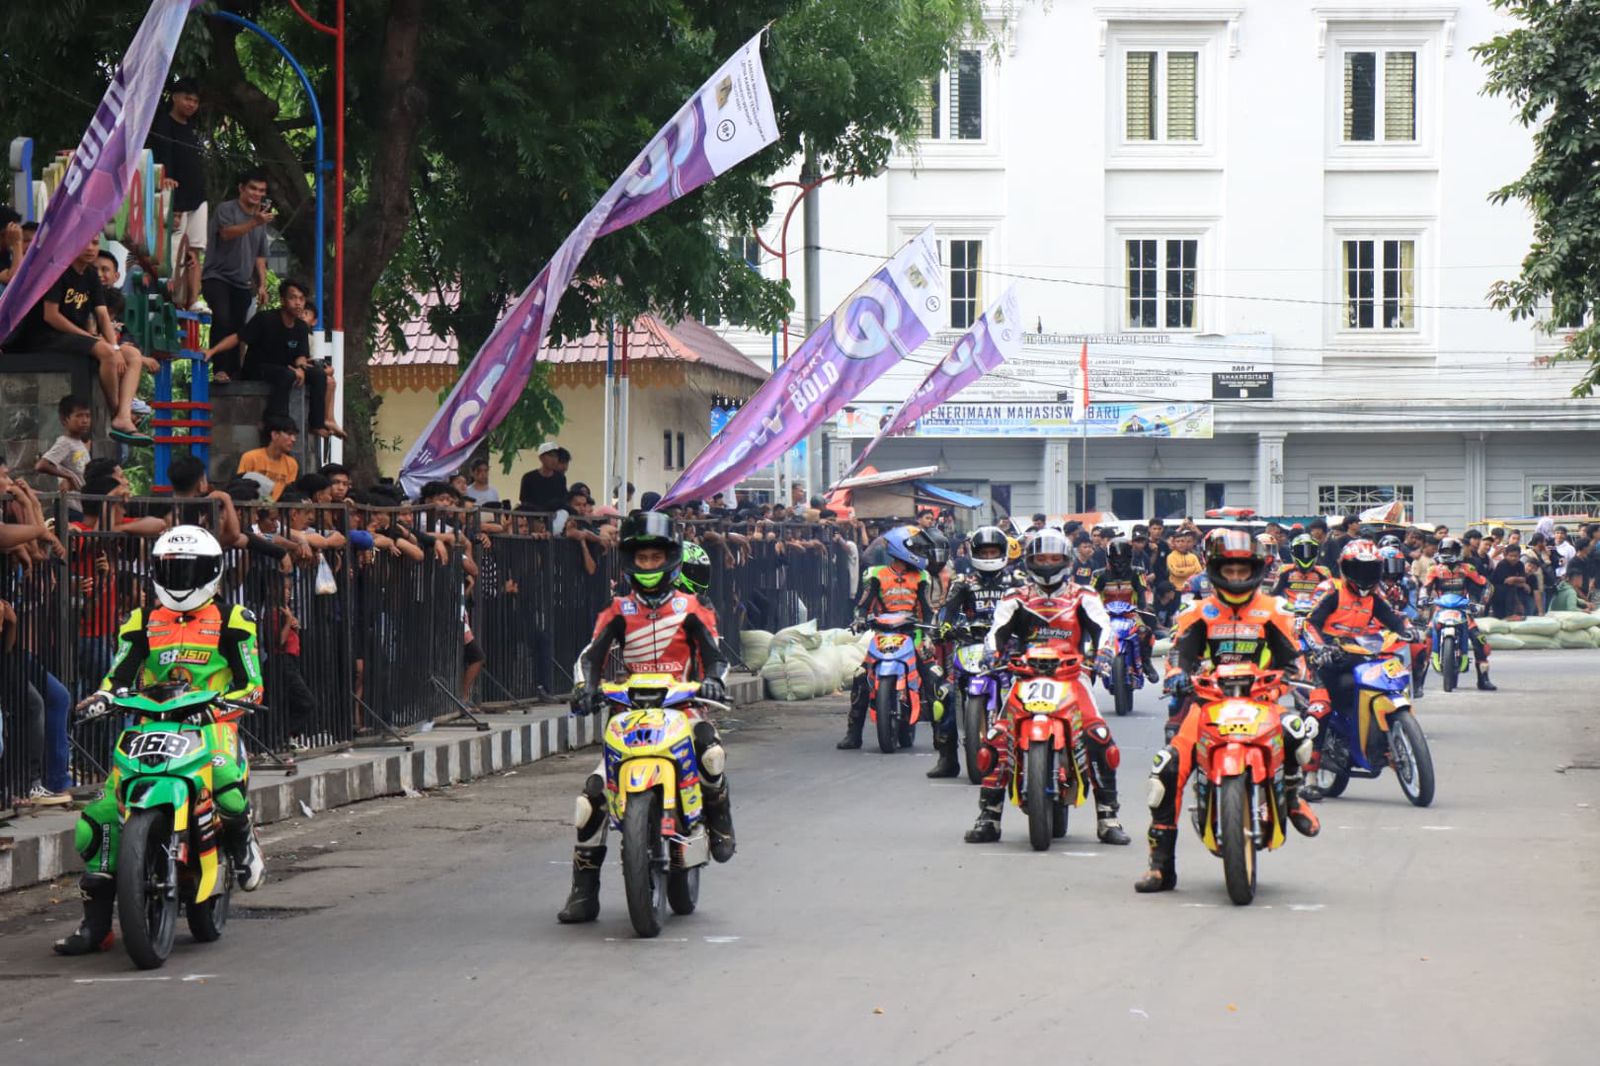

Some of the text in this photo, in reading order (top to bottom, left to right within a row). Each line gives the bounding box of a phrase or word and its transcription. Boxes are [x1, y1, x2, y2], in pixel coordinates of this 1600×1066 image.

[790, 360, 840, 414] BOLD
[1088, 406, 1121, 419] BARU
[631, 662, 684, 672] HONDA
[1028, 682, 1055, 700] 20
[130, 733, 188, 758] 168
